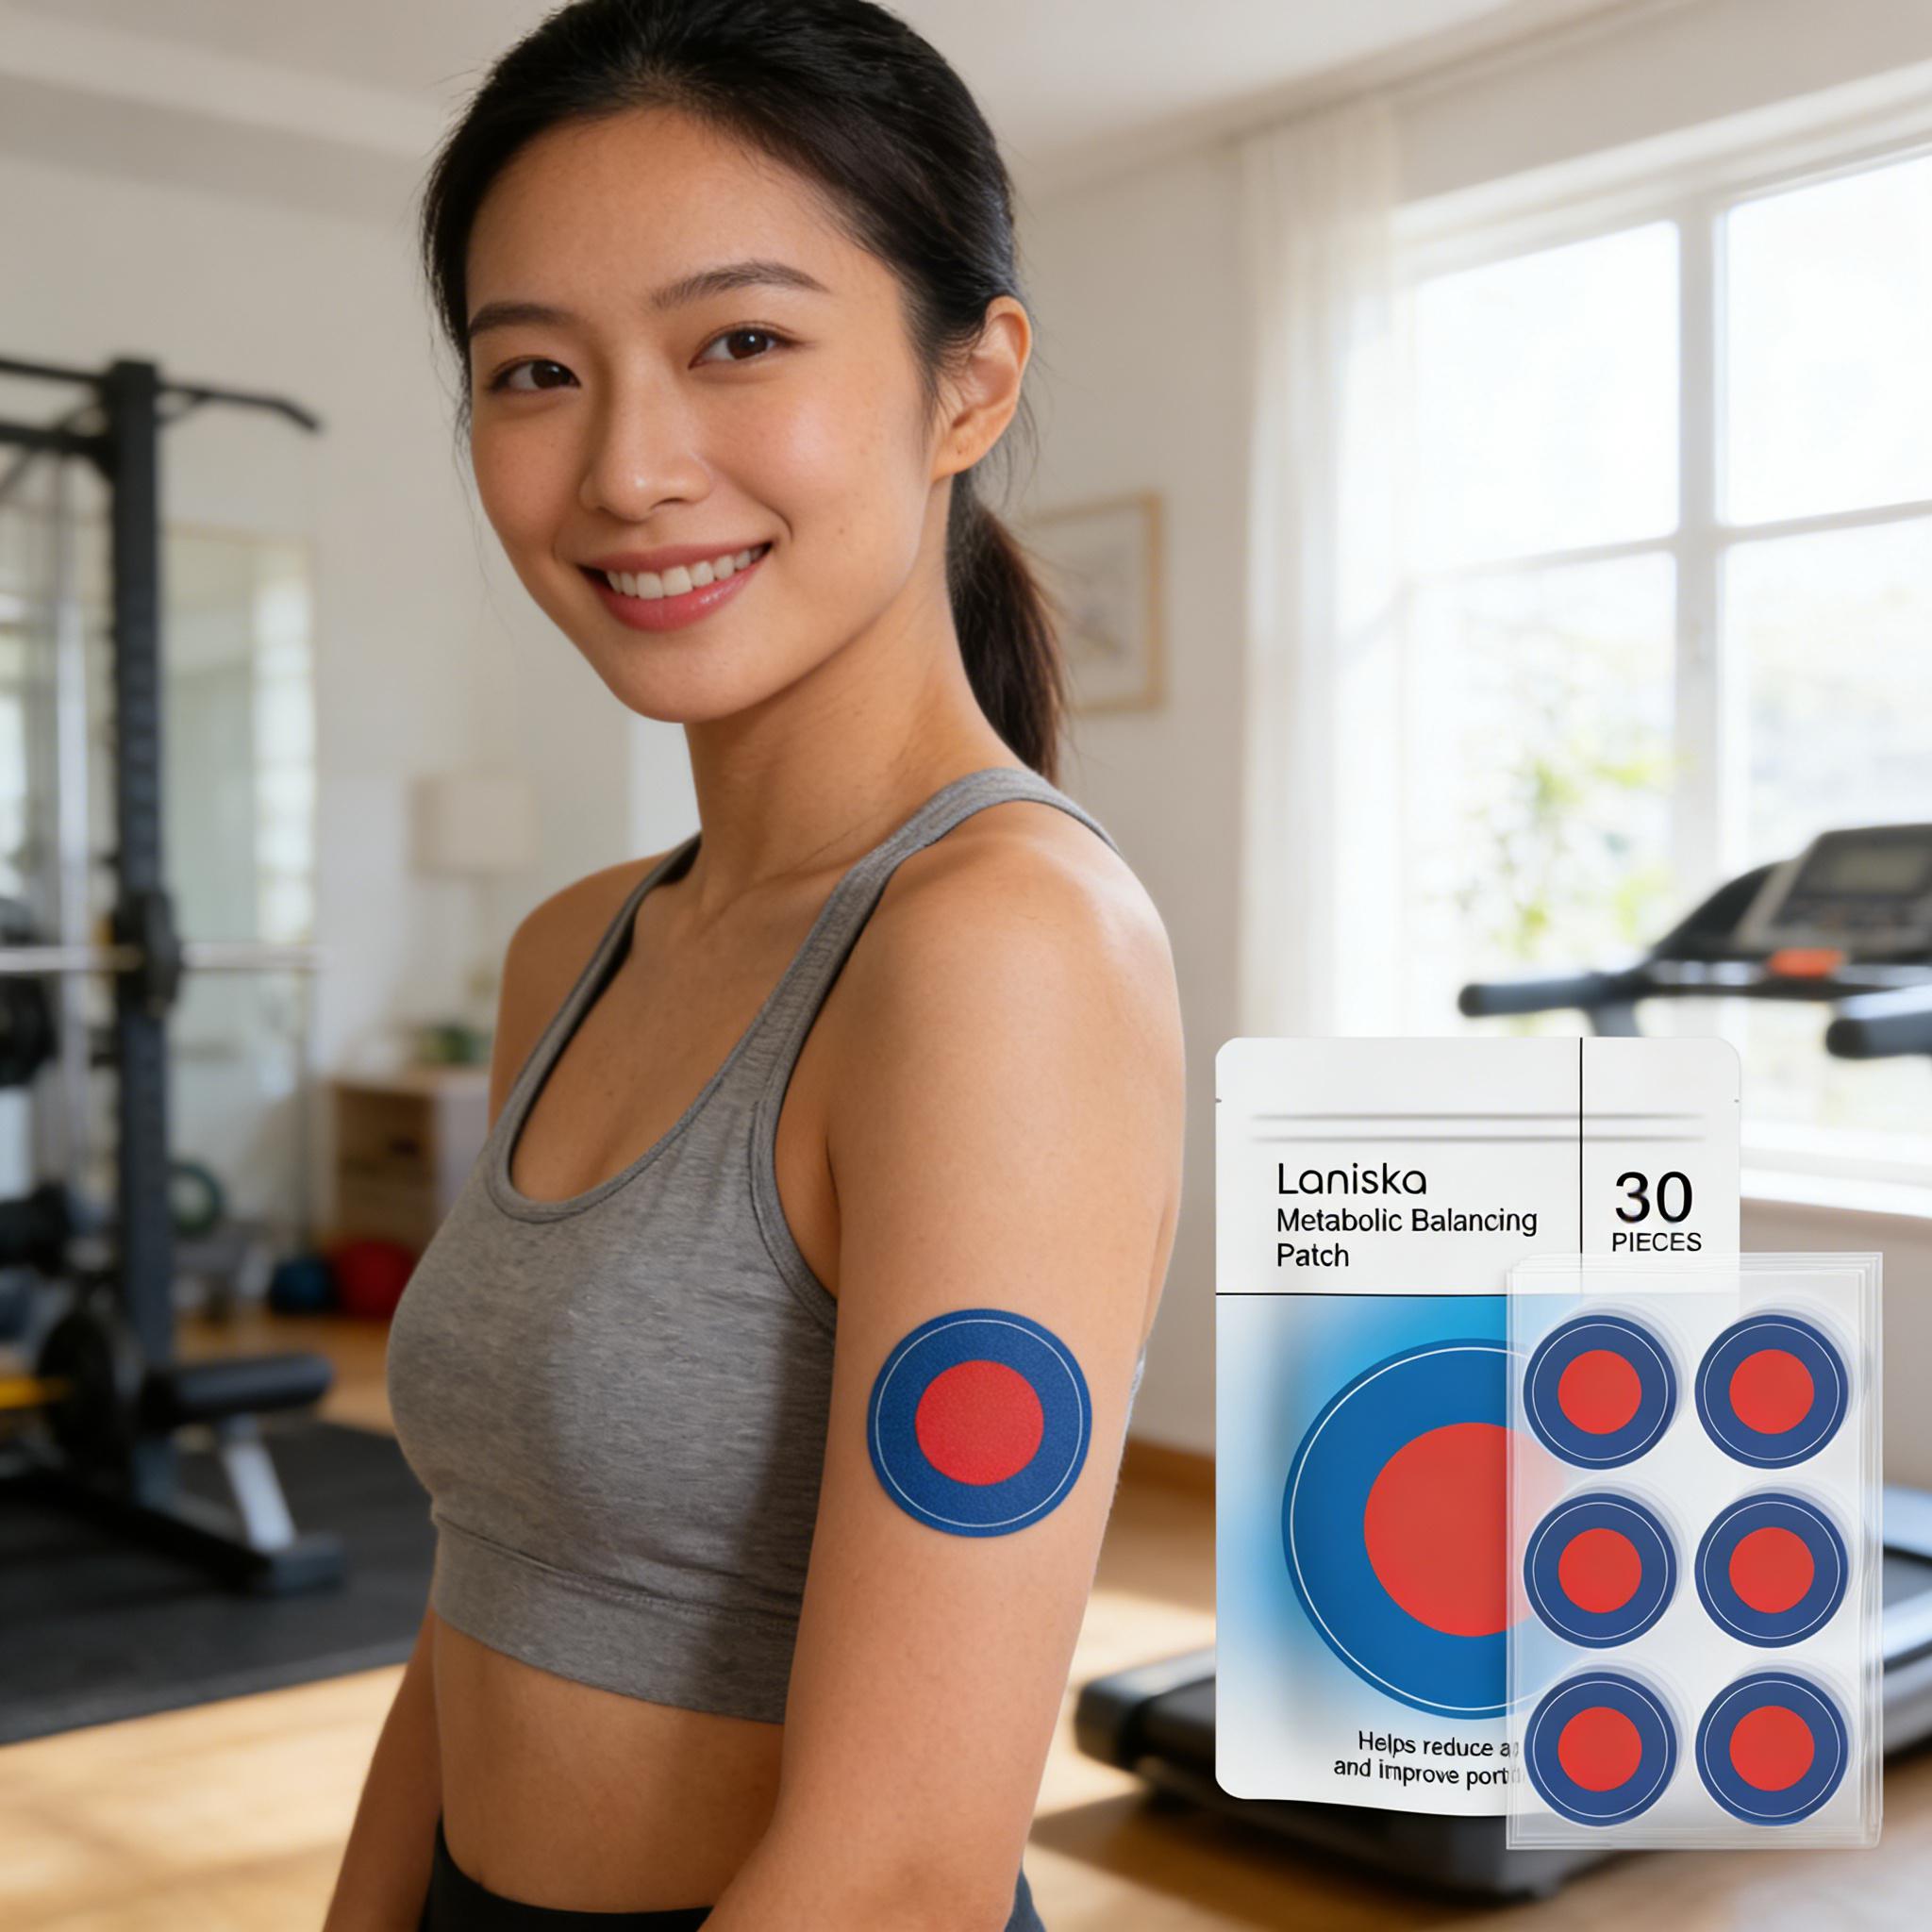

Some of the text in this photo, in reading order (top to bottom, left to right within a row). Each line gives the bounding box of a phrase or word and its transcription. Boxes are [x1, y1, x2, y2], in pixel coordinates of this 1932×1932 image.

[1278, 1162, 1427, 1195] Laniska
[1615, 1171, 1692, 1224] 30
[1277, 1208, 1538, 1238] Metabolic Balancing
[1277, 1242, 1349, 1267] Patch
[1612, 1231, 1702, 1253] PIECES
[1358, 1730, 1416, 1758] Helps
[1423, 1737, 1494, 1757] reduce
[1333, 1758, 1372, 1778] and
[1378, 1759, 1459, 1787] improve
